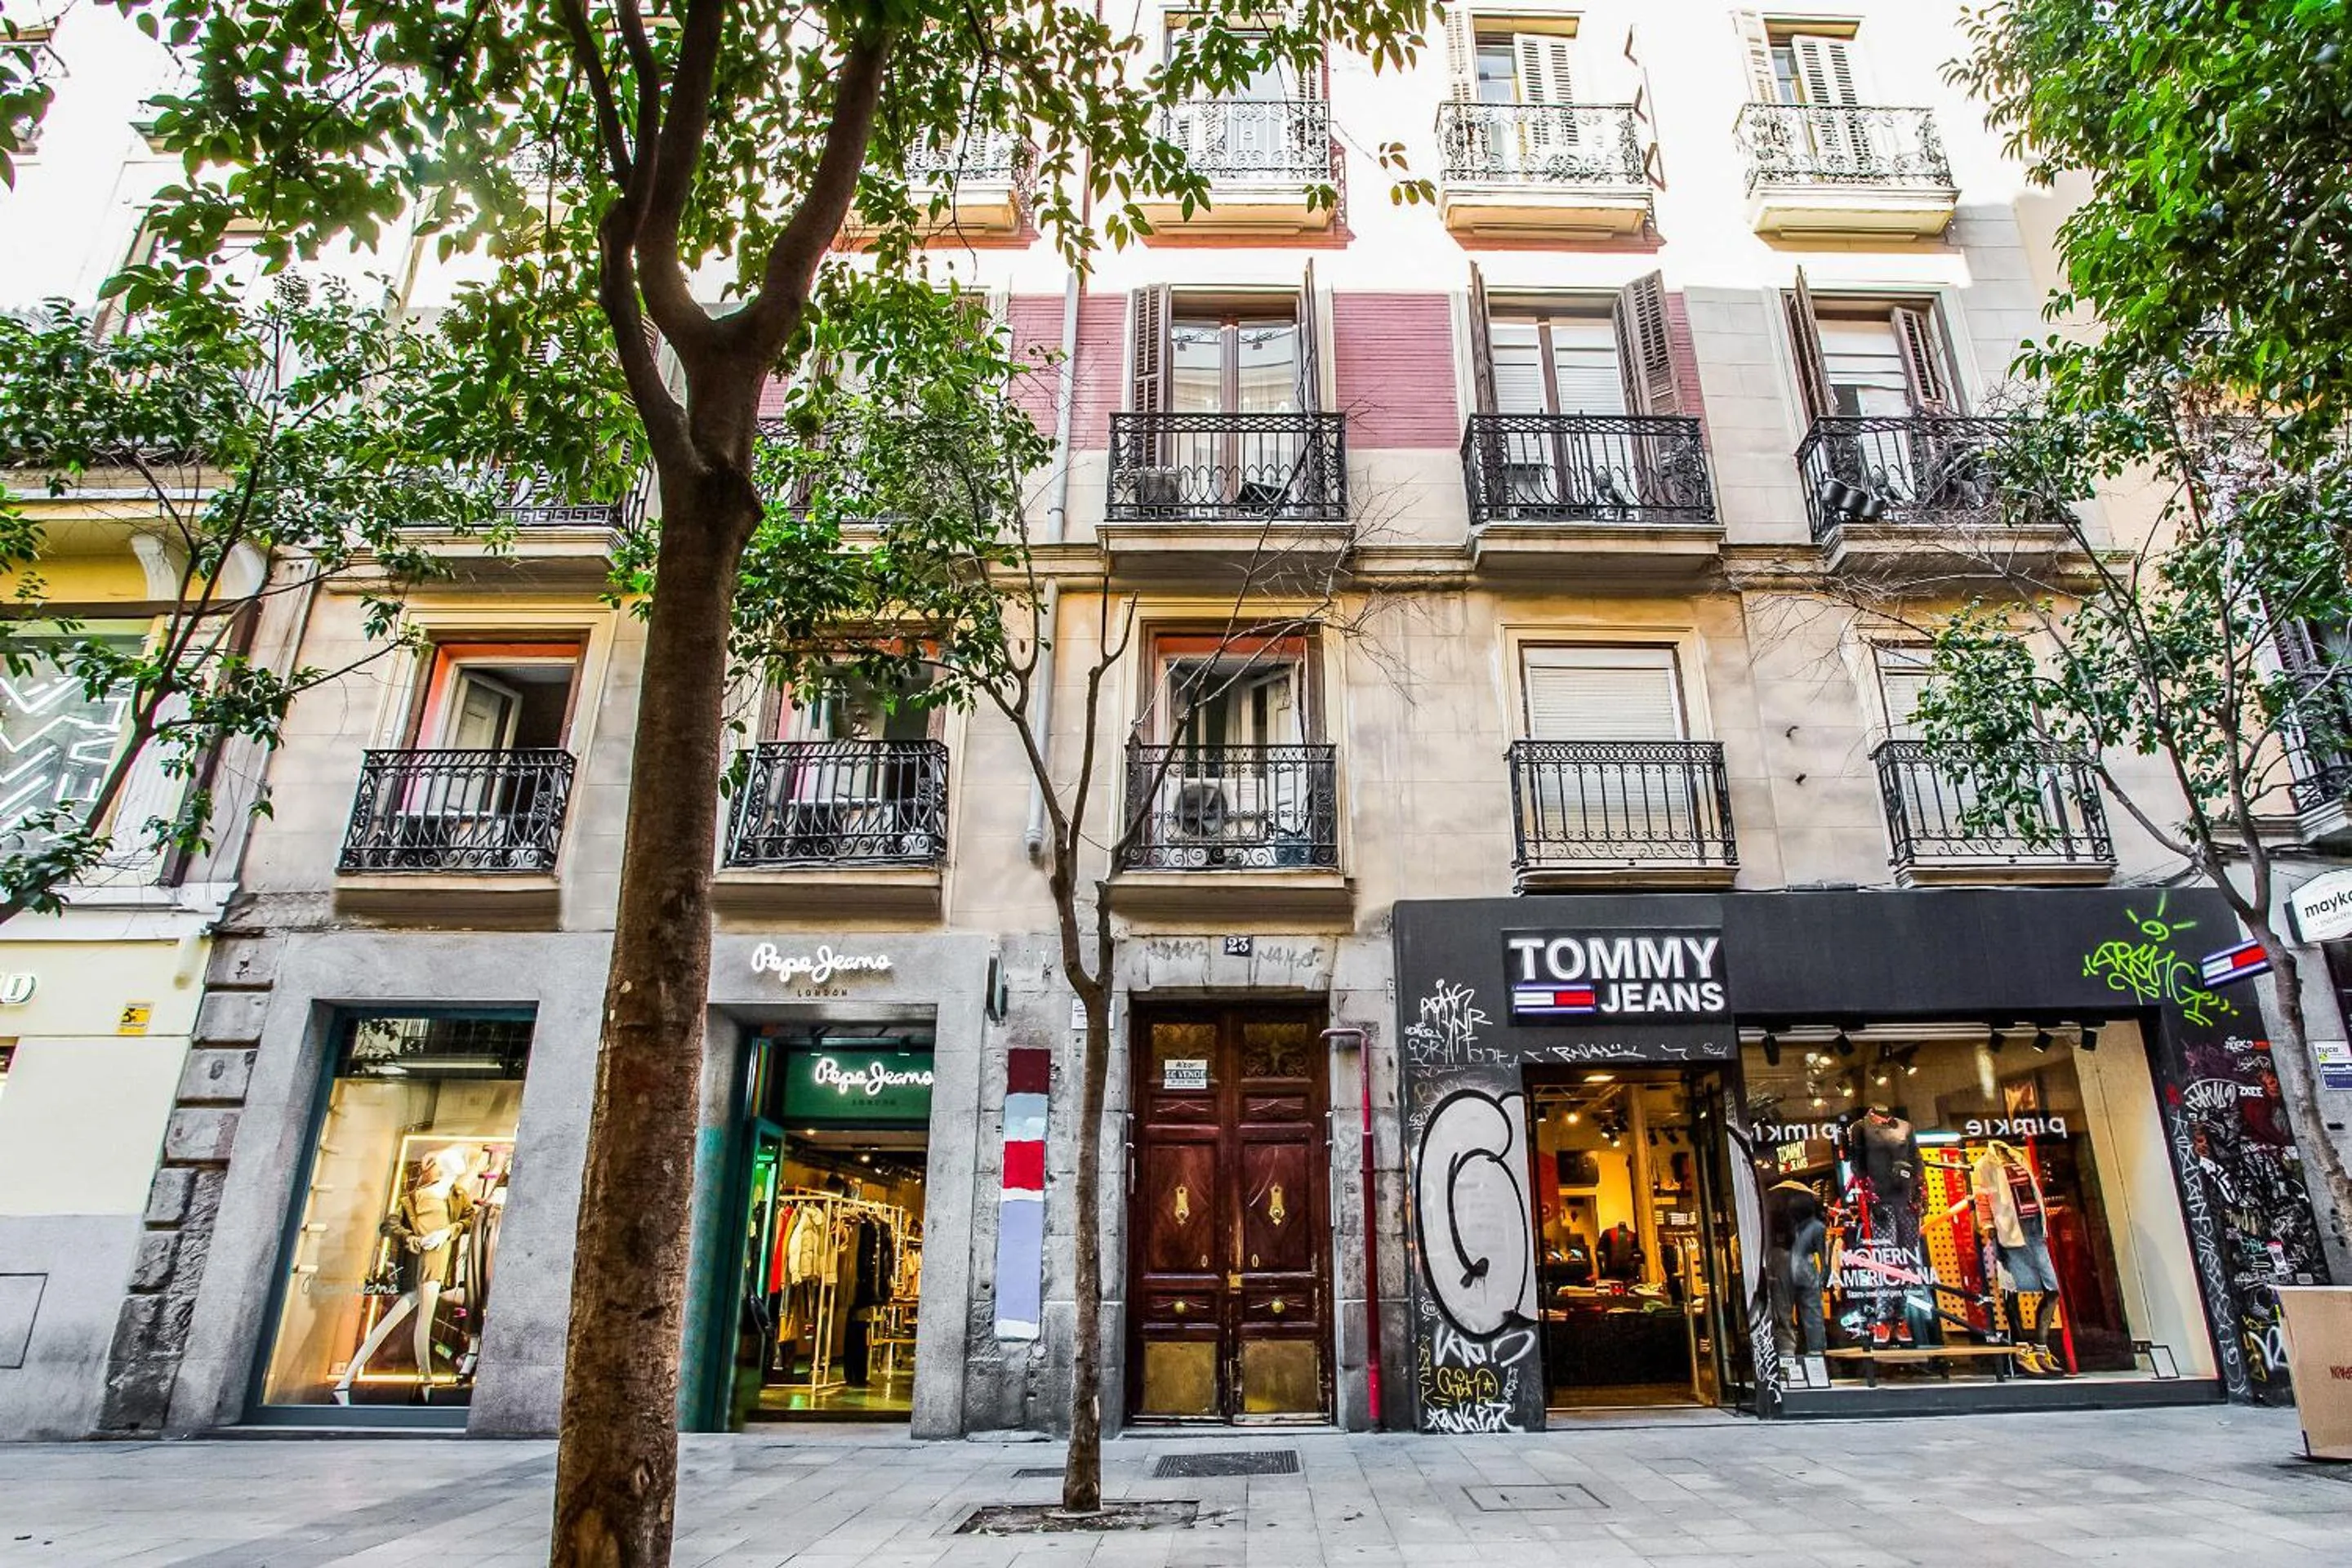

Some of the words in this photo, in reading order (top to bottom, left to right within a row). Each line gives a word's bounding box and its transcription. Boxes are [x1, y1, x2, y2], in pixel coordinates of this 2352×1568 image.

[1227, 937, 1250, 953] 23
[751, 943, 814, 982] Pepe
[811, 945, 893, 983] Jeans
[1508, 938, 1719, 981] TOMMY
[797, 989, 848, 997] LONDON
[1601, 983, 1726, 1013] JEANS
[815, 1058, 867, 1094] Pepe
[865, 1061, 933, 1095] Jeans
[1840, 1245, 1923, 1267] MODERN
[1826, 1266, 1941, 1288] AMERICANA
